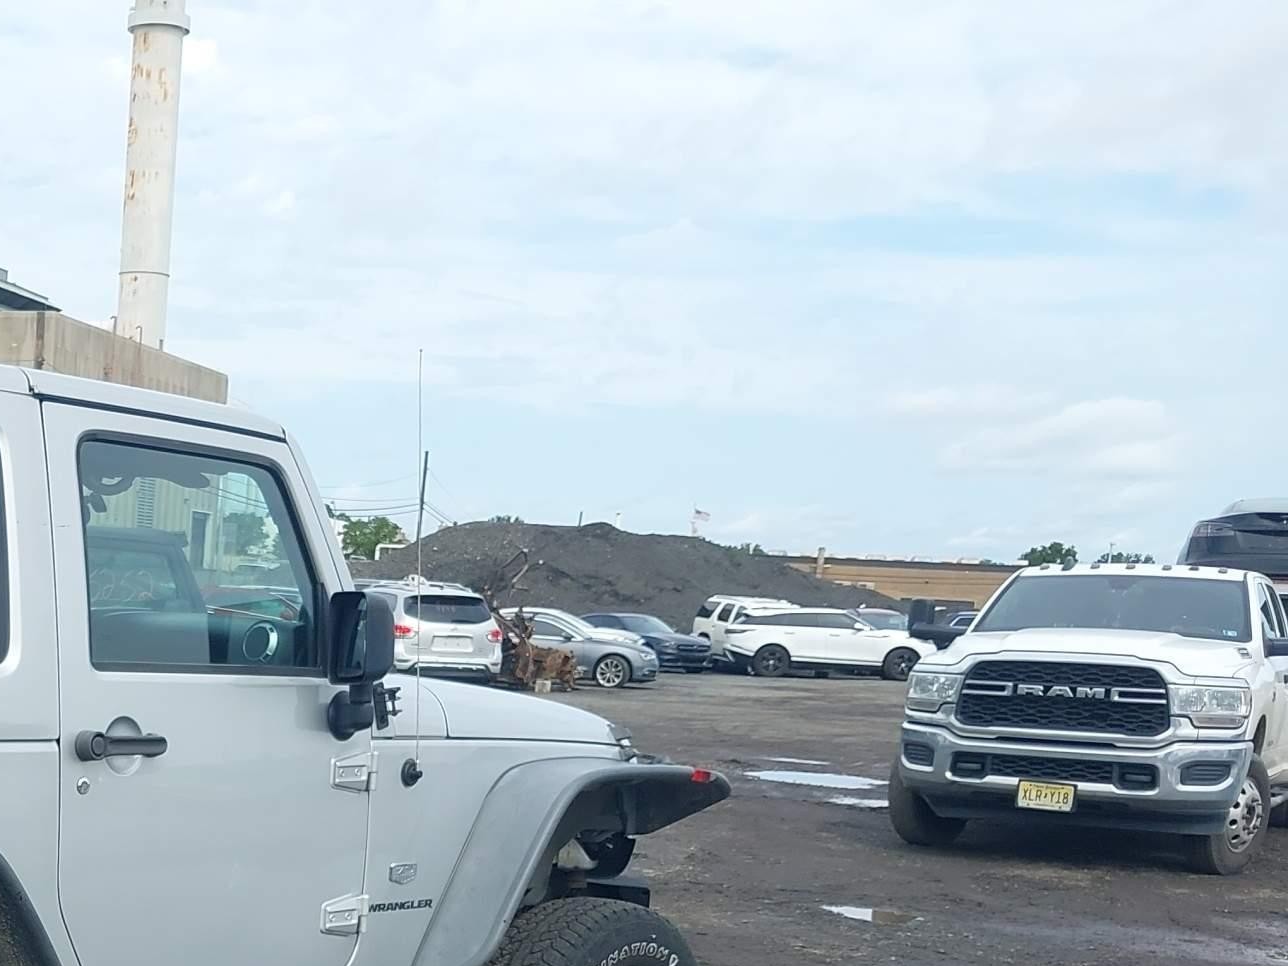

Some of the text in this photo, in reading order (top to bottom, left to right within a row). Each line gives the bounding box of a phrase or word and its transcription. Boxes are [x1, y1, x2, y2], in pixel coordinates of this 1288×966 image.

[1016, 684, 1106, 699] RAM
[1022, 787, 1043, 802] XLR
[368, 898, 433, 913] WRANGLER
